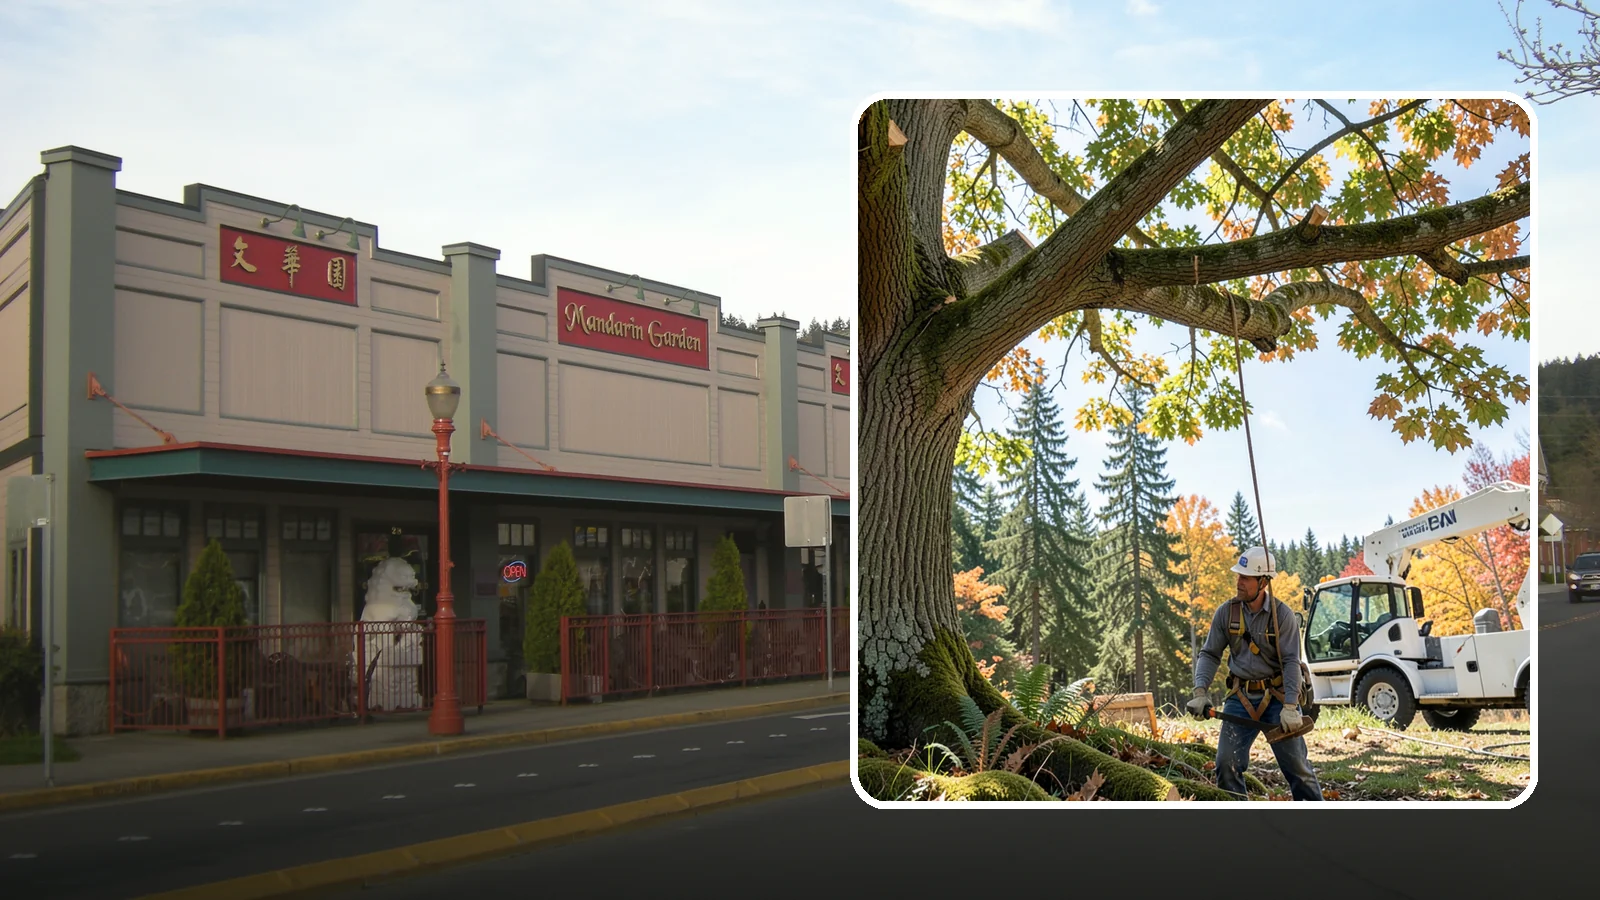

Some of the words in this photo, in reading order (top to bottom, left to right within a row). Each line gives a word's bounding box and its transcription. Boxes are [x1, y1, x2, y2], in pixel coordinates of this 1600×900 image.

[230, 235, 346, 291] 文華園
[564, 302, 644, 341] Mandarin
[648, 320, 701, 352] Garden
[503, 565, 527, 578] OPEN
